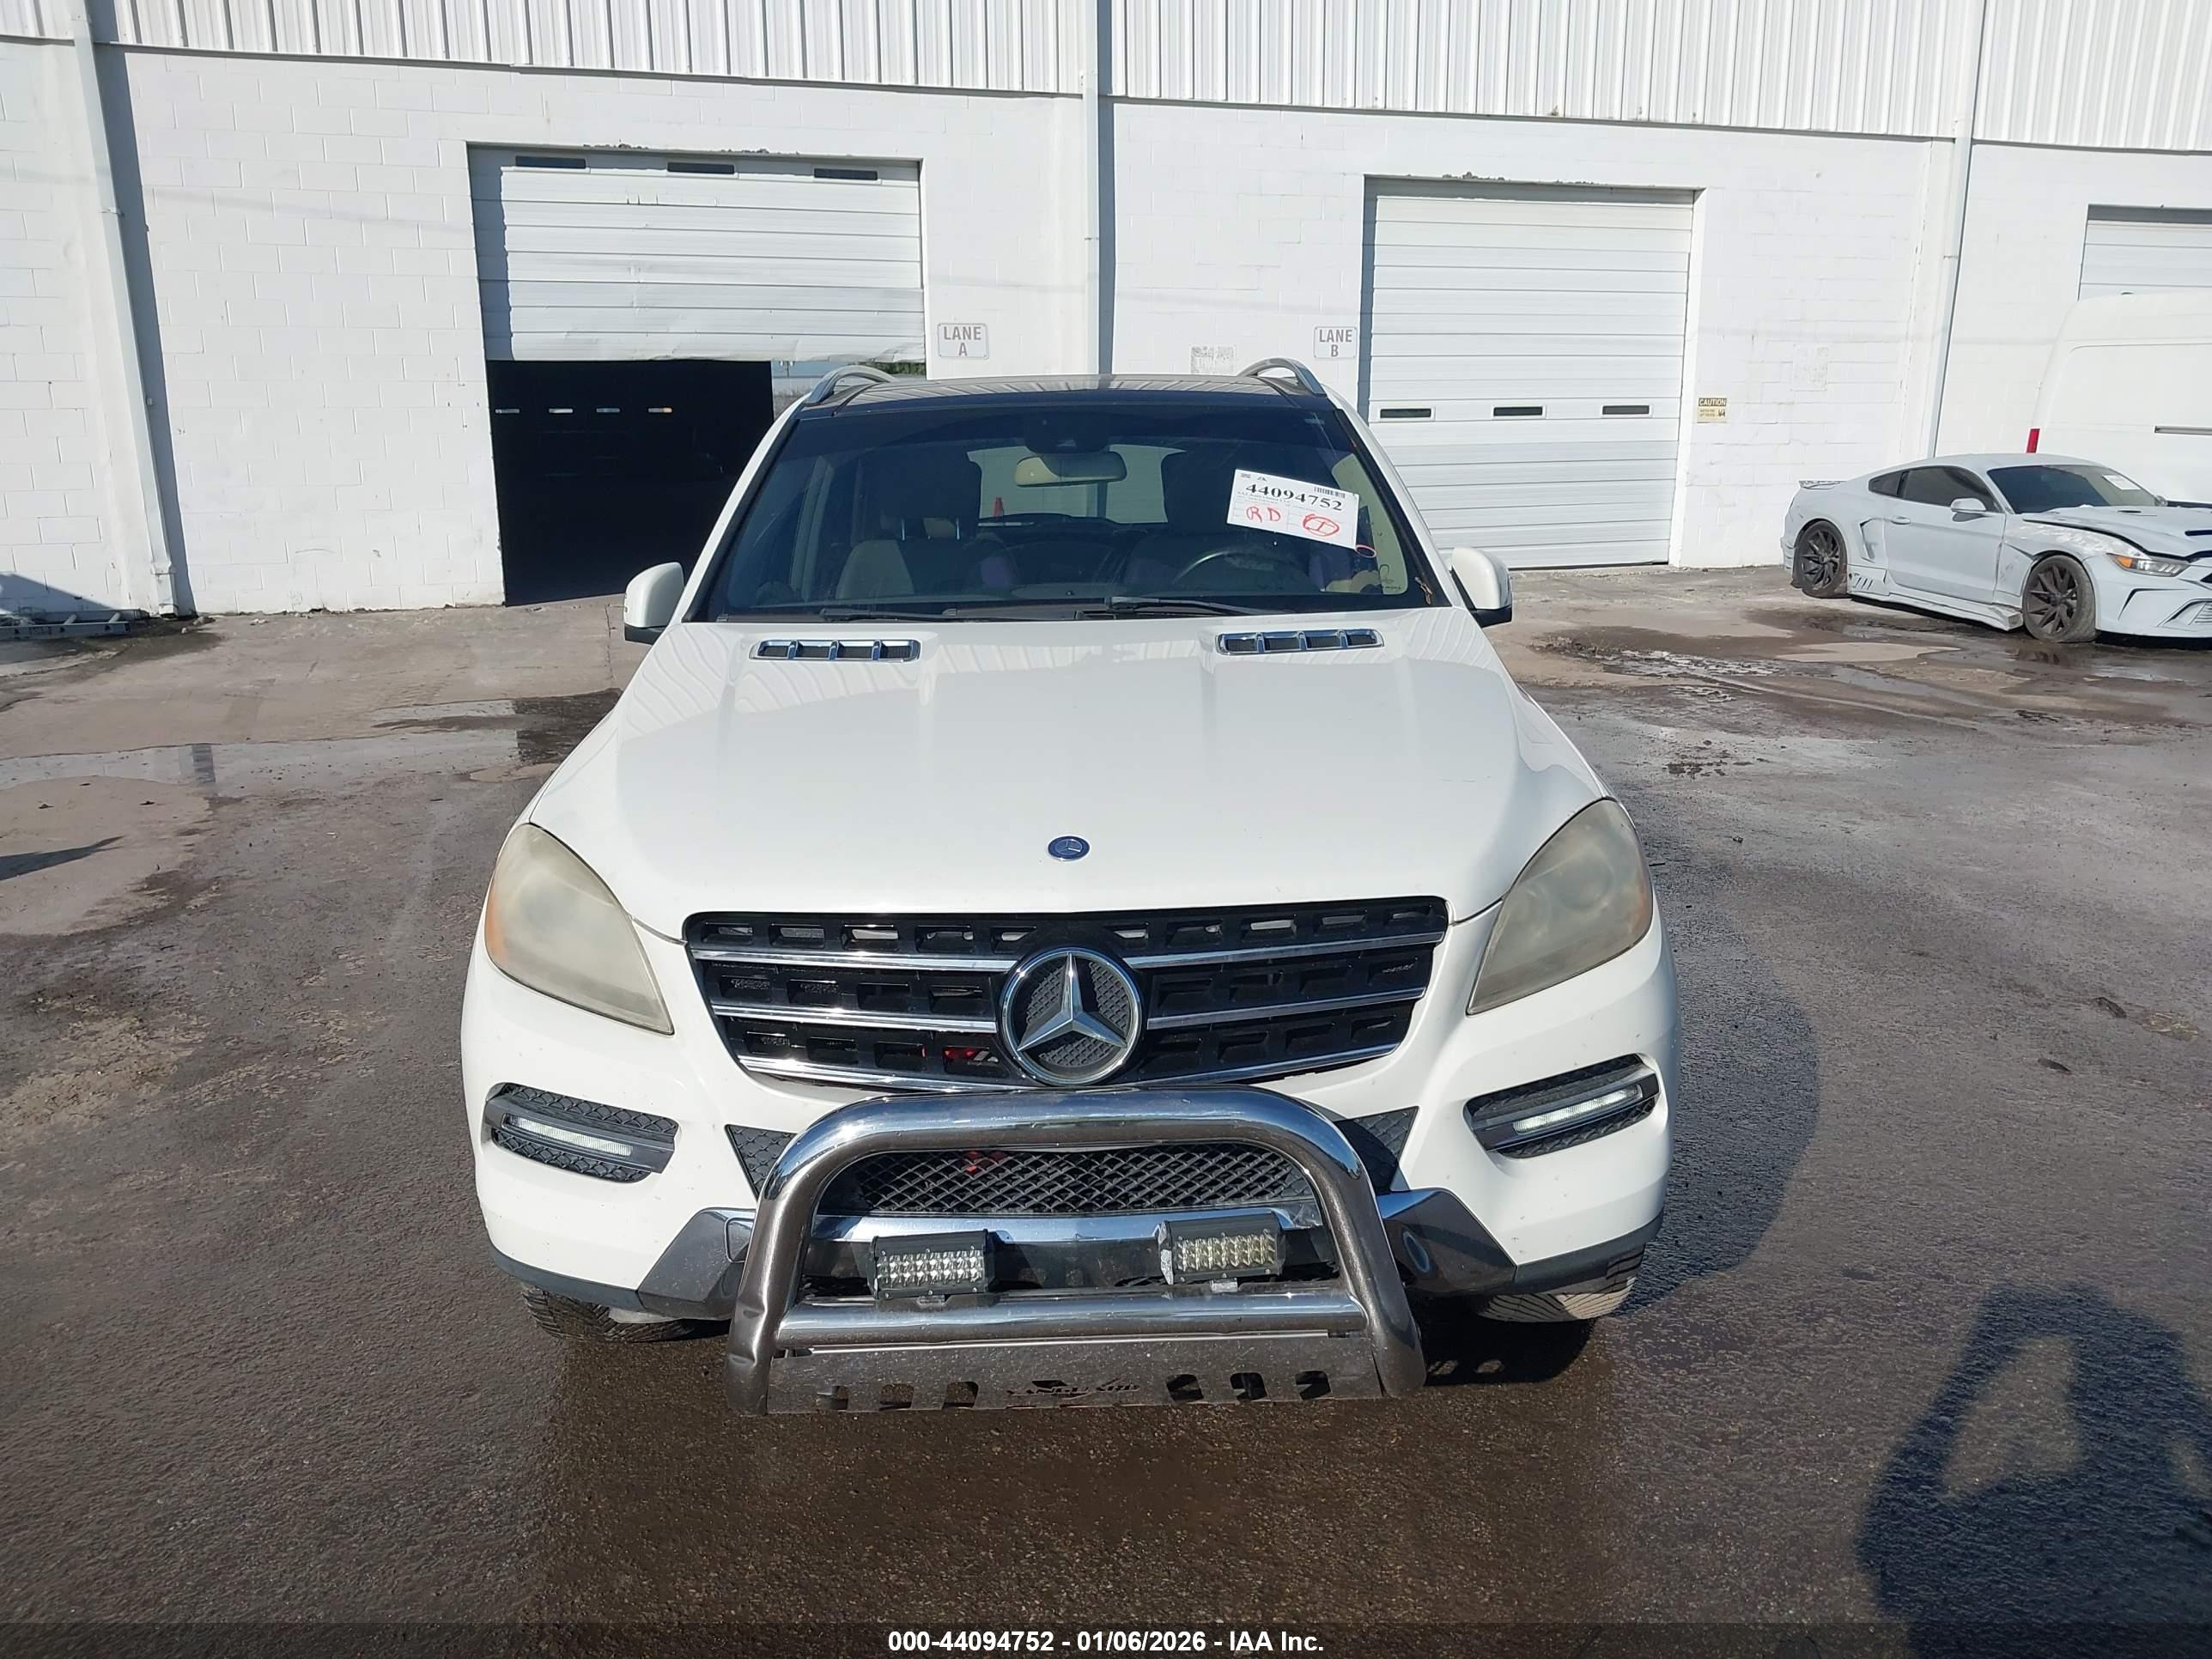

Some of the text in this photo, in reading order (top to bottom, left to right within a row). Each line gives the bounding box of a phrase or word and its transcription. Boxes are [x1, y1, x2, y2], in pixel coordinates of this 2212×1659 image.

[944, 326, 981, 340] LANE
[1318, 329, 1352, 343] LANE
[958, 342, 968, 356] A
[1331, 344, 1339, 357] B
[1245, 483, 1343, 512] 44094752
